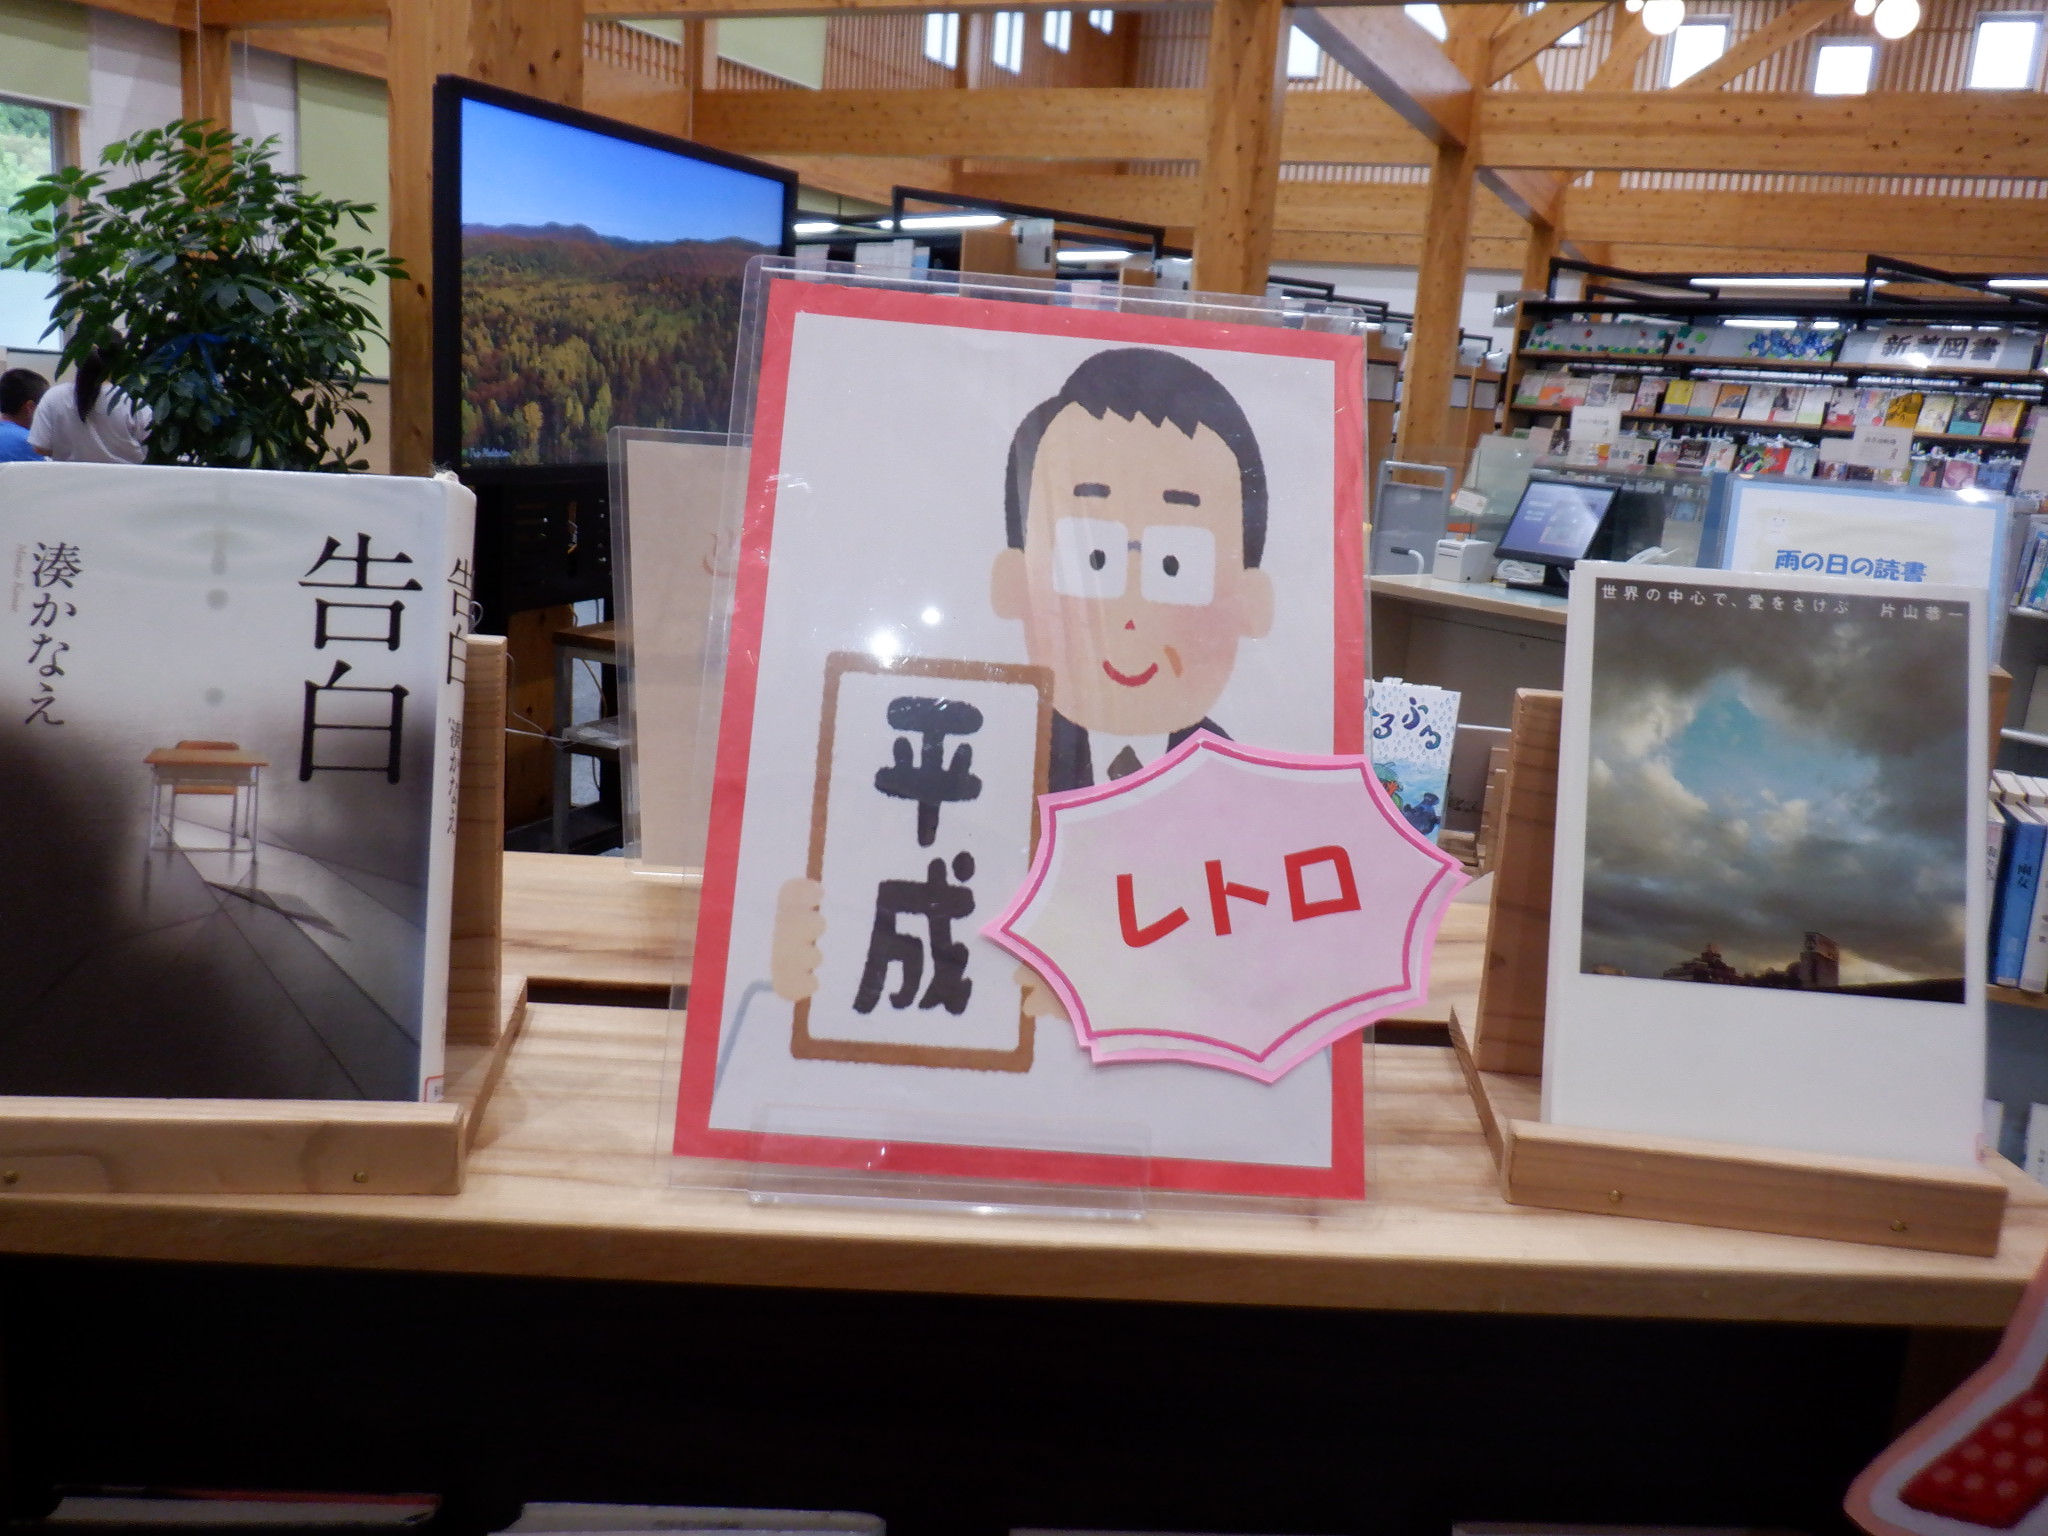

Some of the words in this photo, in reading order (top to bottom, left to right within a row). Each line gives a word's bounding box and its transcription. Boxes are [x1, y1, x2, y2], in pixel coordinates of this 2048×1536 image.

[1880, 333, 2000, 362] 新着図書
[1601, 583, 1849, 614] 世界の中心で、愛をさけぶ
[1880, 602, 1964, 622] 片山恭一
[1775, 549, 1927, 583] 雨の日の読書
[25, 542, 82, 725] 湊かなえ
[298, 532, 422, 783] 告白
[852, 696, 984, 1015] 平成
[1116, 844, 1362, 948] レトロ
